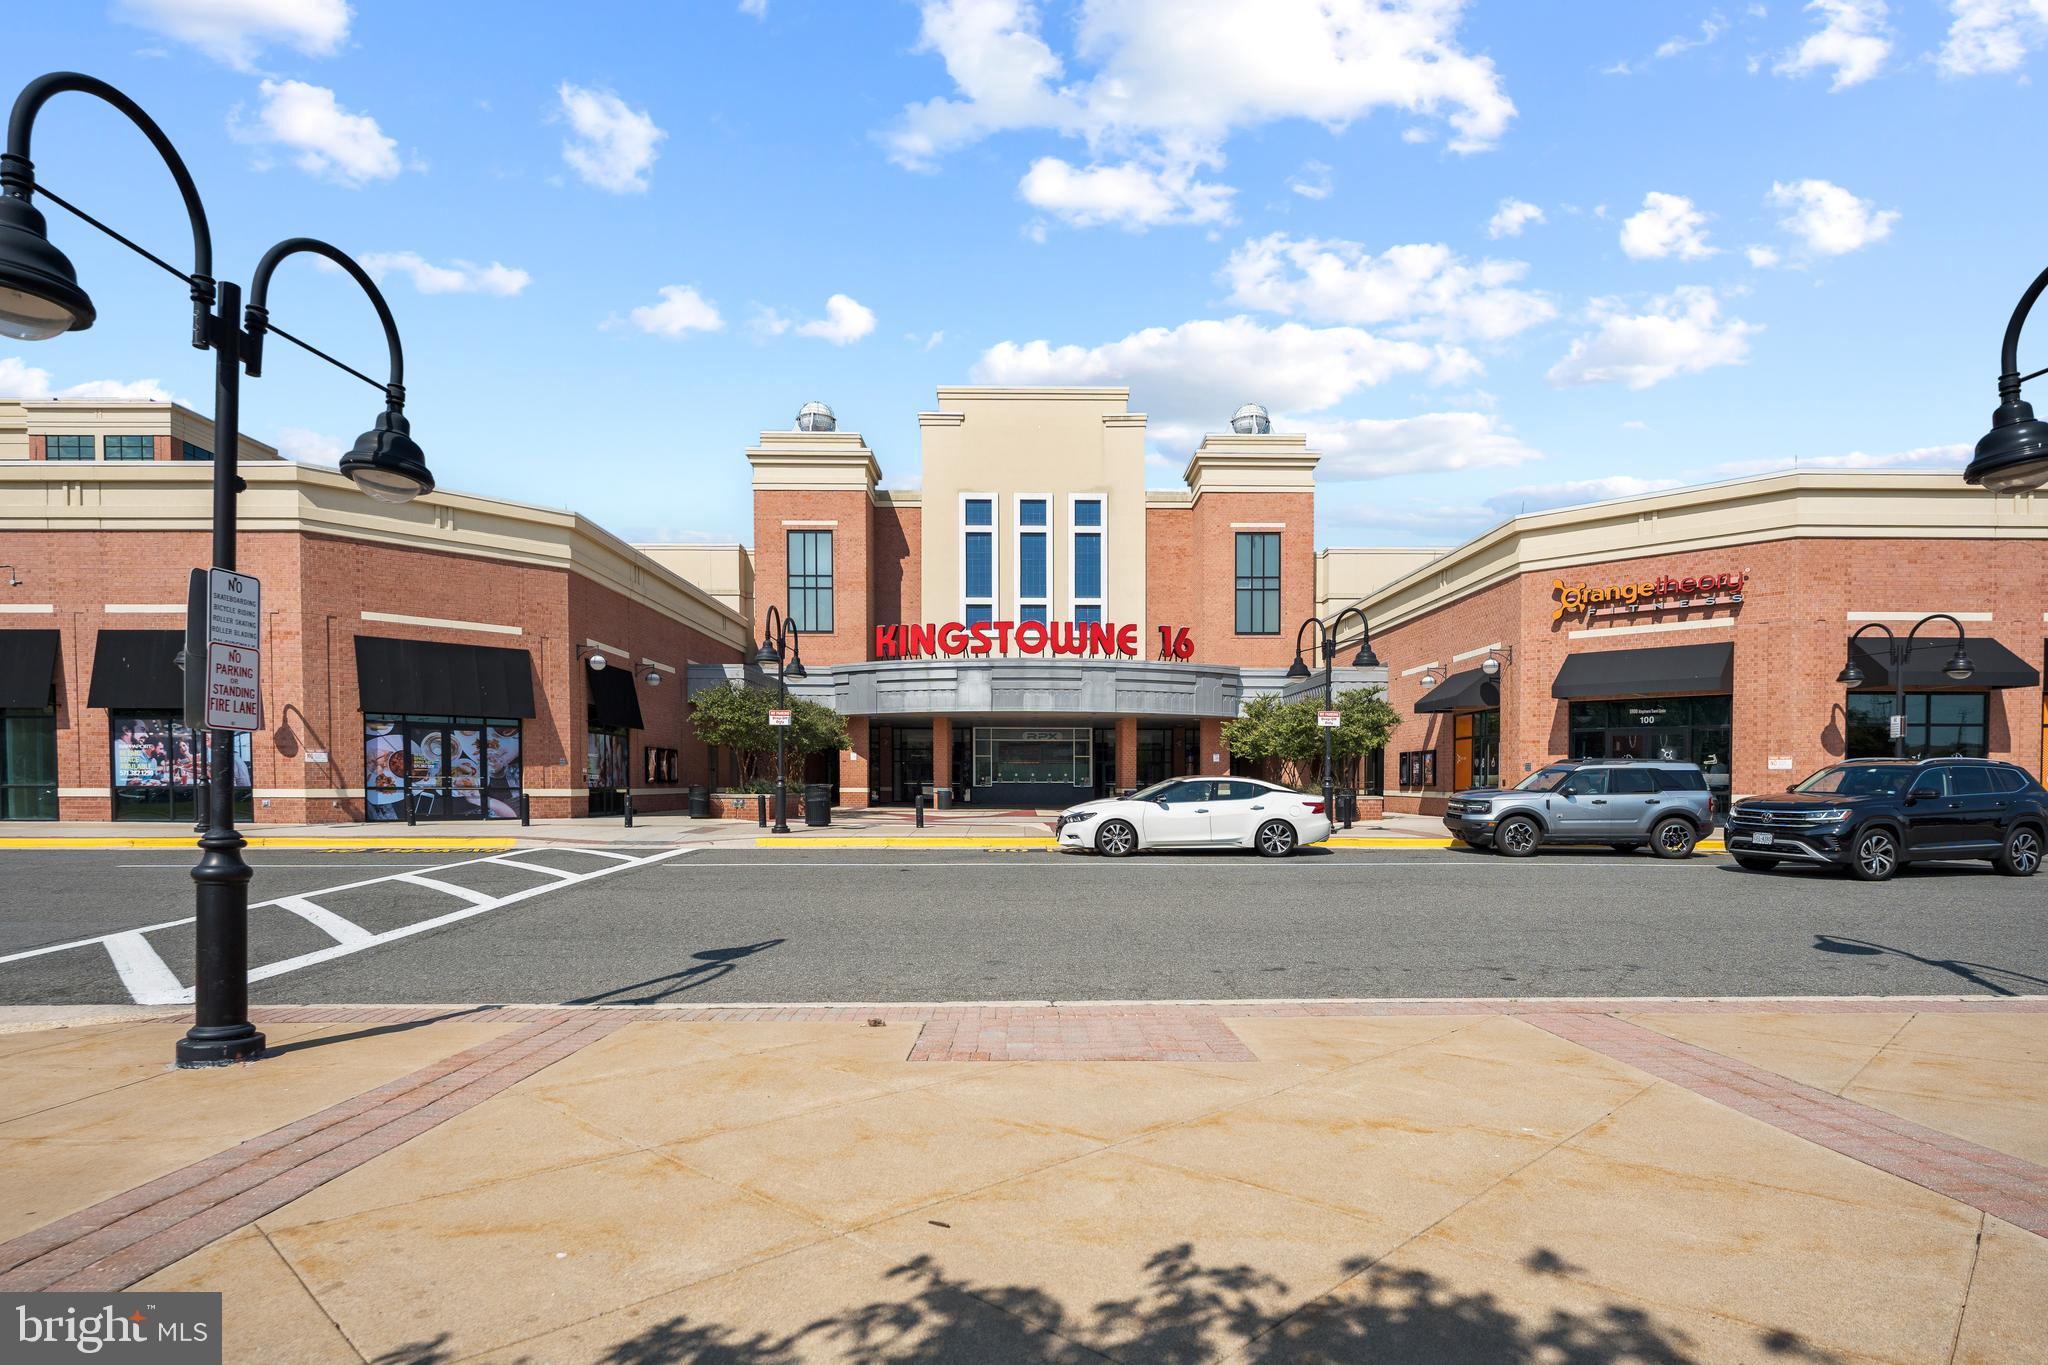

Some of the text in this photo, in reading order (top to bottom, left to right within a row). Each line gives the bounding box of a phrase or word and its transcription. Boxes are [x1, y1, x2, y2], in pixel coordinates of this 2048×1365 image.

[228, 578, 243, 594] NO
[213, 593, 256, 607] SKATEBOARDING
[1587, 594, 1744, 616] FITNESS
[213, 603, 256, 618] BICYCLE RIDING
[213, 614, 257, 629] ROLLER SKATING
[212, 625, 257, 640] ROLLER BLADING
[875, 620, 1195, 658] KINGSTOWNE 16
[228, 651, 242, 664] NO
[215, 663, 254, 679] PARKING
[213, 684, 256, 700] STANDING
[210, 698, 257, 716] FIRE LANE
[1640, 716, 1655, 724] 100
